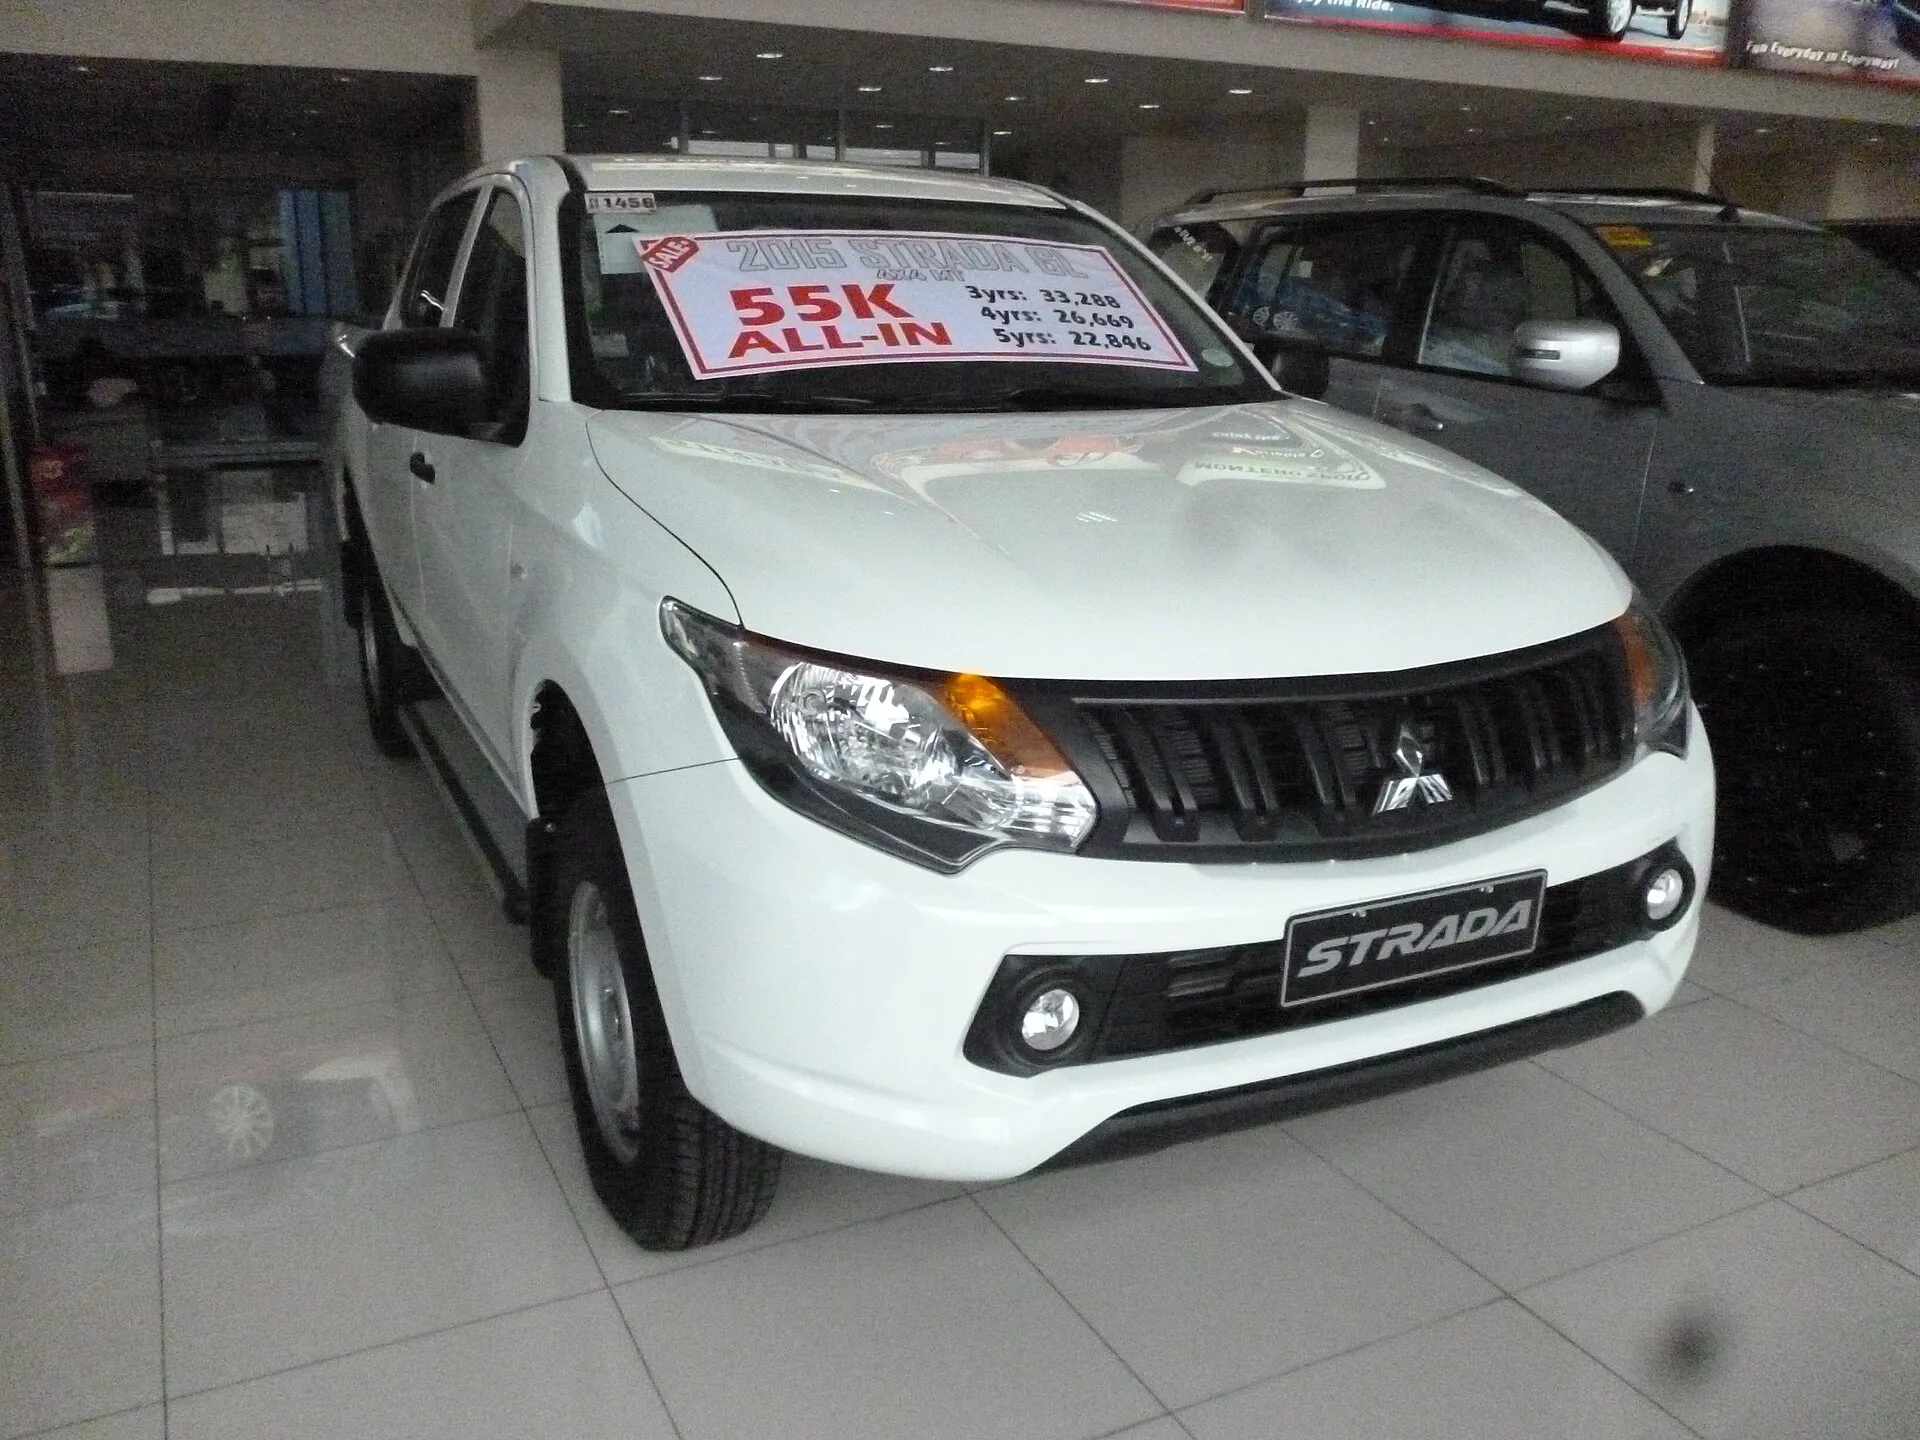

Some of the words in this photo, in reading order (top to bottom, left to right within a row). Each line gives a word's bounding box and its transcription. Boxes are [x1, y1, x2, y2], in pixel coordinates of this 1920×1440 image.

[726, 240, 847, 272] 2015
[850, 238, 1029, 274] STRADA
[729, 283, 915, 327] 55K
[965, 285, 1028, 303] 3yrs:
[1038, 289, 1122, 309] 33,288
[981, 306, 1042, 324] 4yrs:
[1053, 309, 1135, 329] 26,669
[728, 323, 953, 358] ALL-IN
[993, 328, 1056, 348] 5yrs:
[1068, 331, 1152, 352] 22,846
[1297, 899, 1533, 977] STRADA
